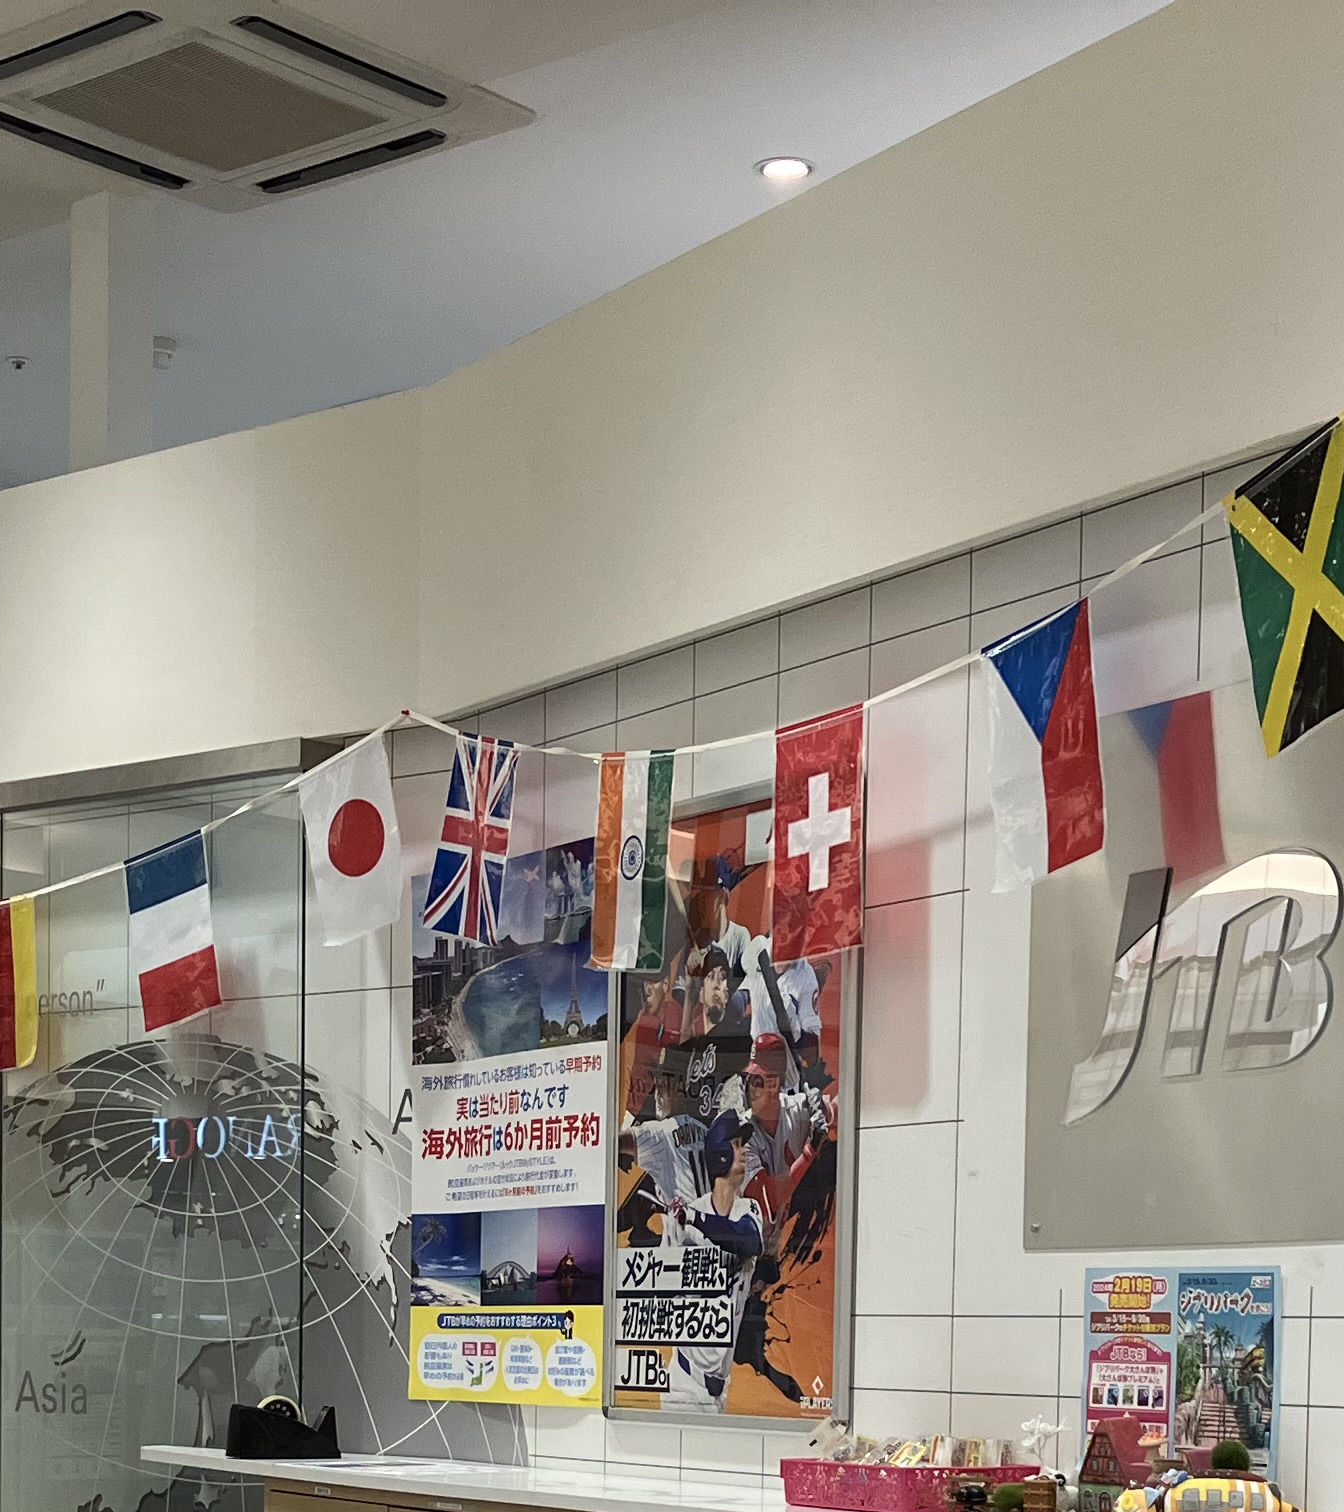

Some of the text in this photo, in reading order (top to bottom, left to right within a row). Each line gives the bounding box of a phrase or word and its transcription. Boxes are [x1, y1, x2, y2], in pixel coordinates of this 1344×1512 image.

[1061, 848, 1344, 1126] JTB
[456, 1084, 569, 1121] 実は当たり前なんです
[421, 1112, 600, 1160] 海外旅行は6か月前予約
[622, 1299, 730, 1340] 初挑戦するなら
[15, 1370, 88, 1415] Asia
